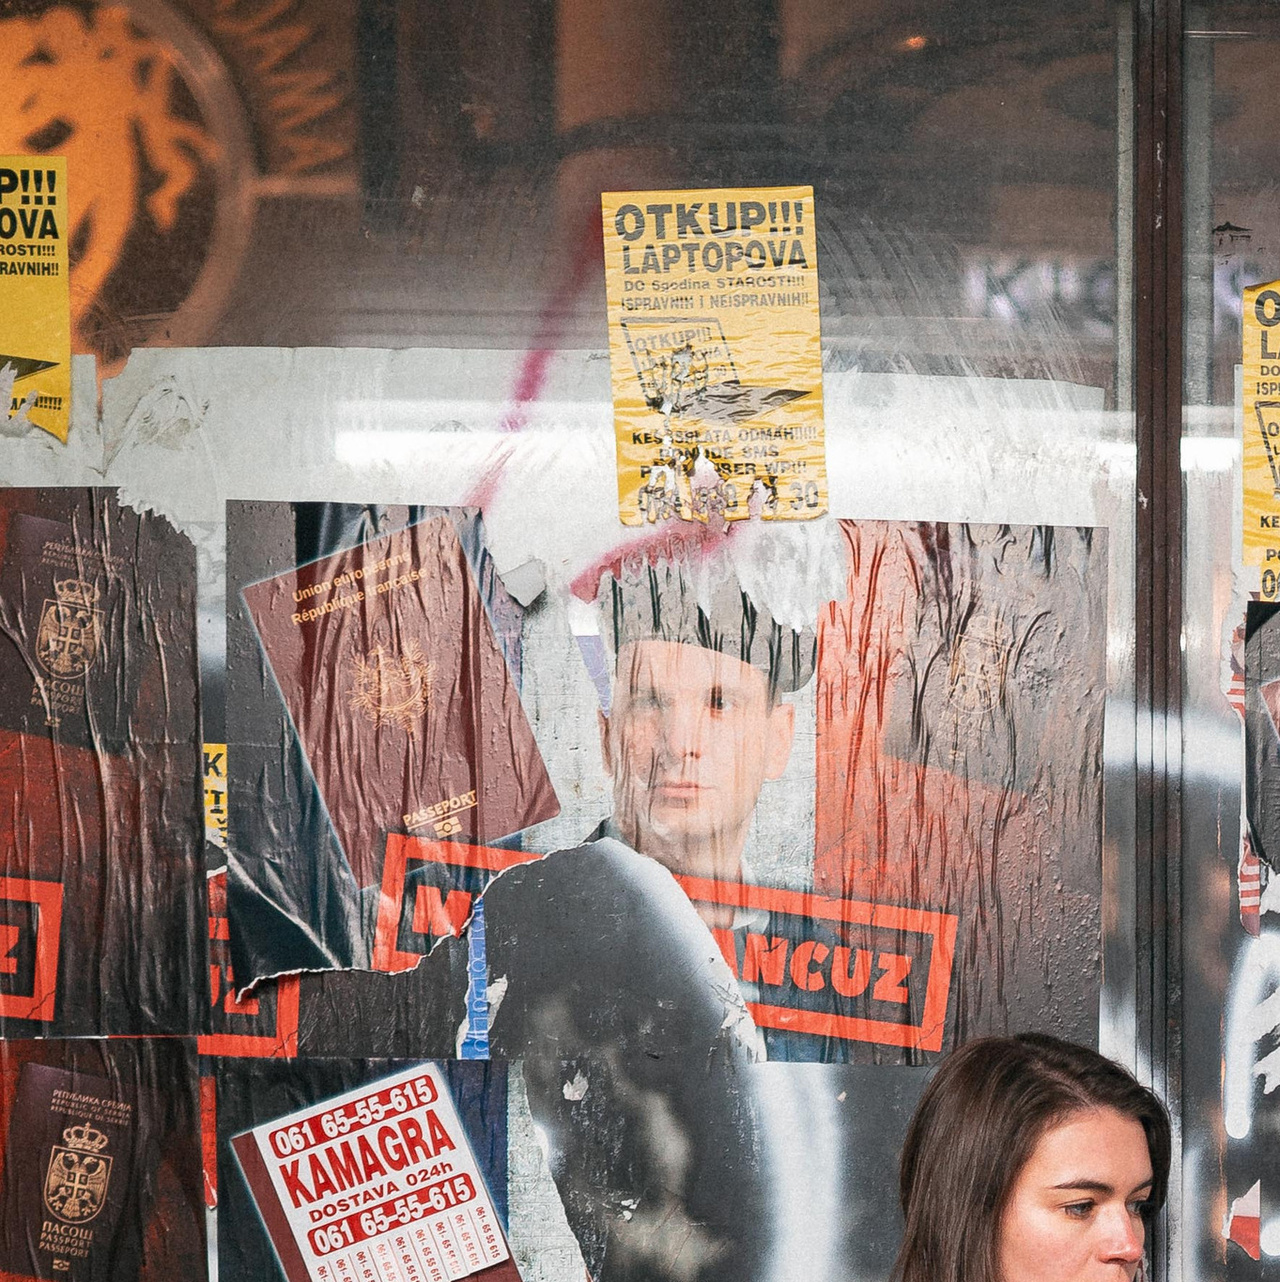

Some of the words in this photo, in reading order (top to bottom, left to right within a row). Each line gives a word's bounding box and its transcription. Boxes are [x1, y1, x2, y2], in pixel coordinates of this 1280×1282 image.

[615, 200, 803, 241] OTKUP!!!
[622, 239, 809, 274] LAPTOPOVA
[1260, 366, 1280, 377] DO
[292, 580, 332, 602] Union
[333, 552, 411, 587] européenne
[291, 590, 365, 626] République
[403, 790, 477, 827] PASSEPORT
[53, 1090, 99, 1107] РЕПУБЛИКА
[275, 1125, 316, 1156] 061
[279, 1108, 456, 1209] KAMAGRA
[308, 1181, 400, 1224] DOSTAVA
[406, 1162, 453, 1187] 024h
[40, 1232, 91, 1249] PASSPORT
[43, 1221, 93, 1241] ПАСОШ
[314, 1222, 355, 1255] 061
[38, 1241, 89, 1258] PASSEPORT
